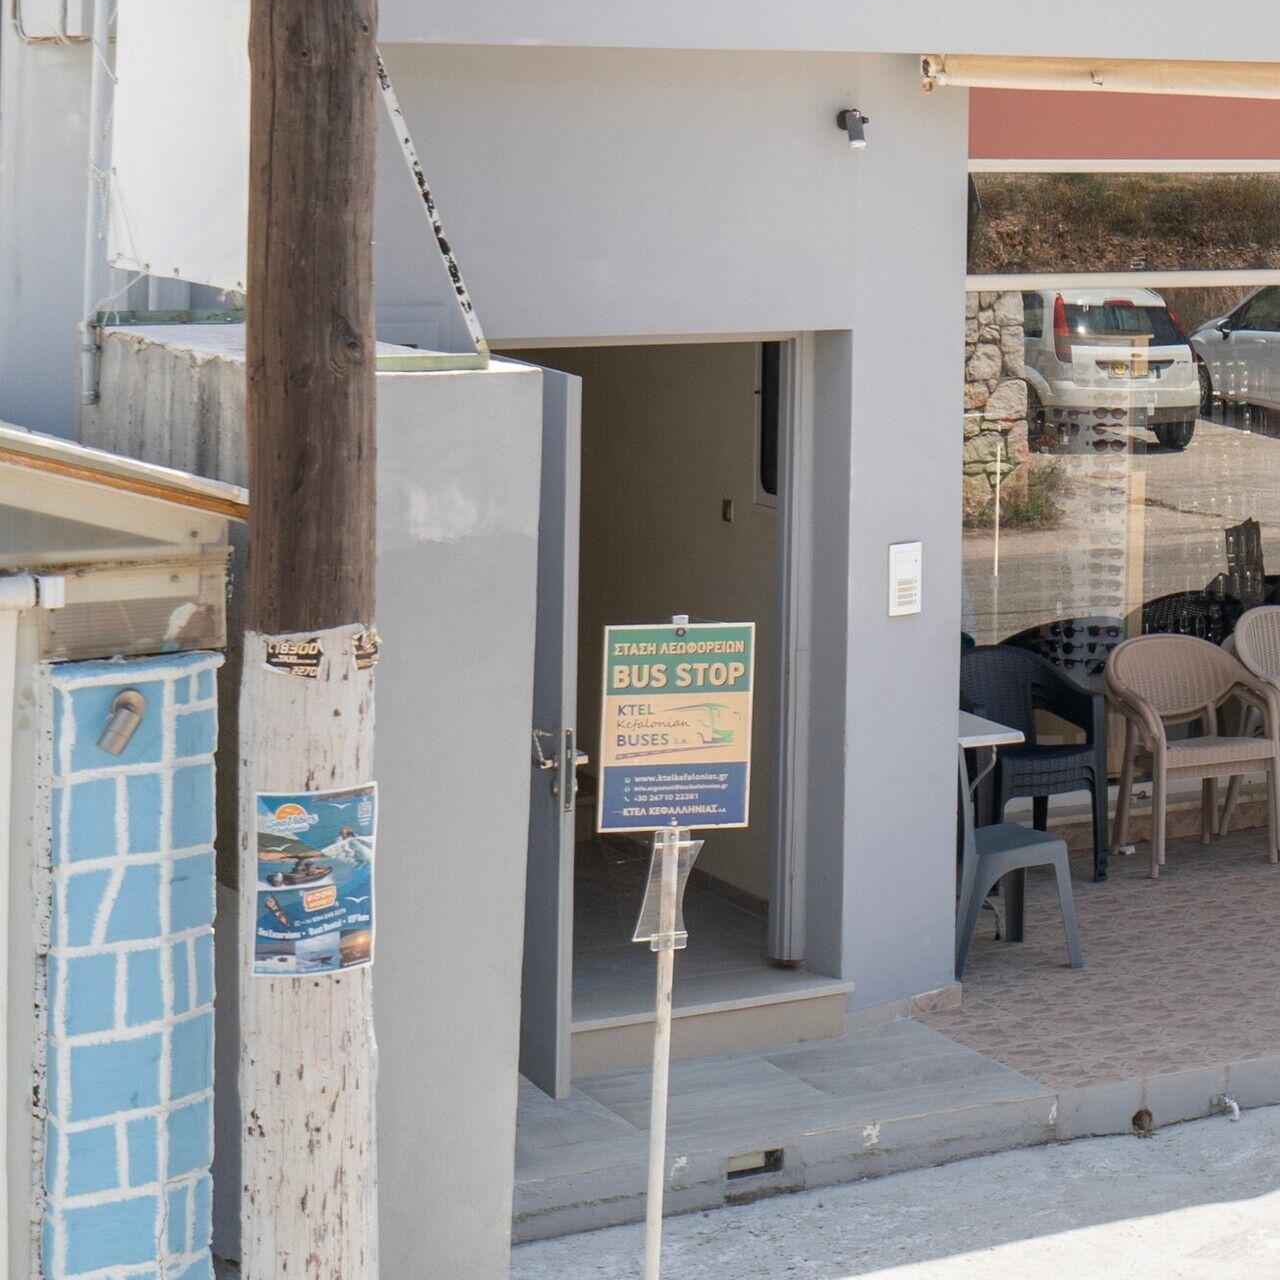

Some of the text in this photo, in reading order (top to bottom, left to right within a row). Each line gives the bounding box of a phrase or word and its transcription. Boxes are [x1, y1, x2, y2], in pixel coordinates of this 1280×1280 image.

[613, 640, 744, 656] ΣΤΑΣΗ ΛΕΩΦΟΡΕΙΩΝ
[613, 662, 746, 689] BUS STOP
[618, 704, 655, 716] KTEL
[616, 718, 690, 732] Kefalonian
[616, 733, 670, 747] BUSES
[622, 807, 647, 816] ΚΤΕΛ
[649, 804, 718, 816] ΚΕΦΑΛΛΗΝΙΑΣ
